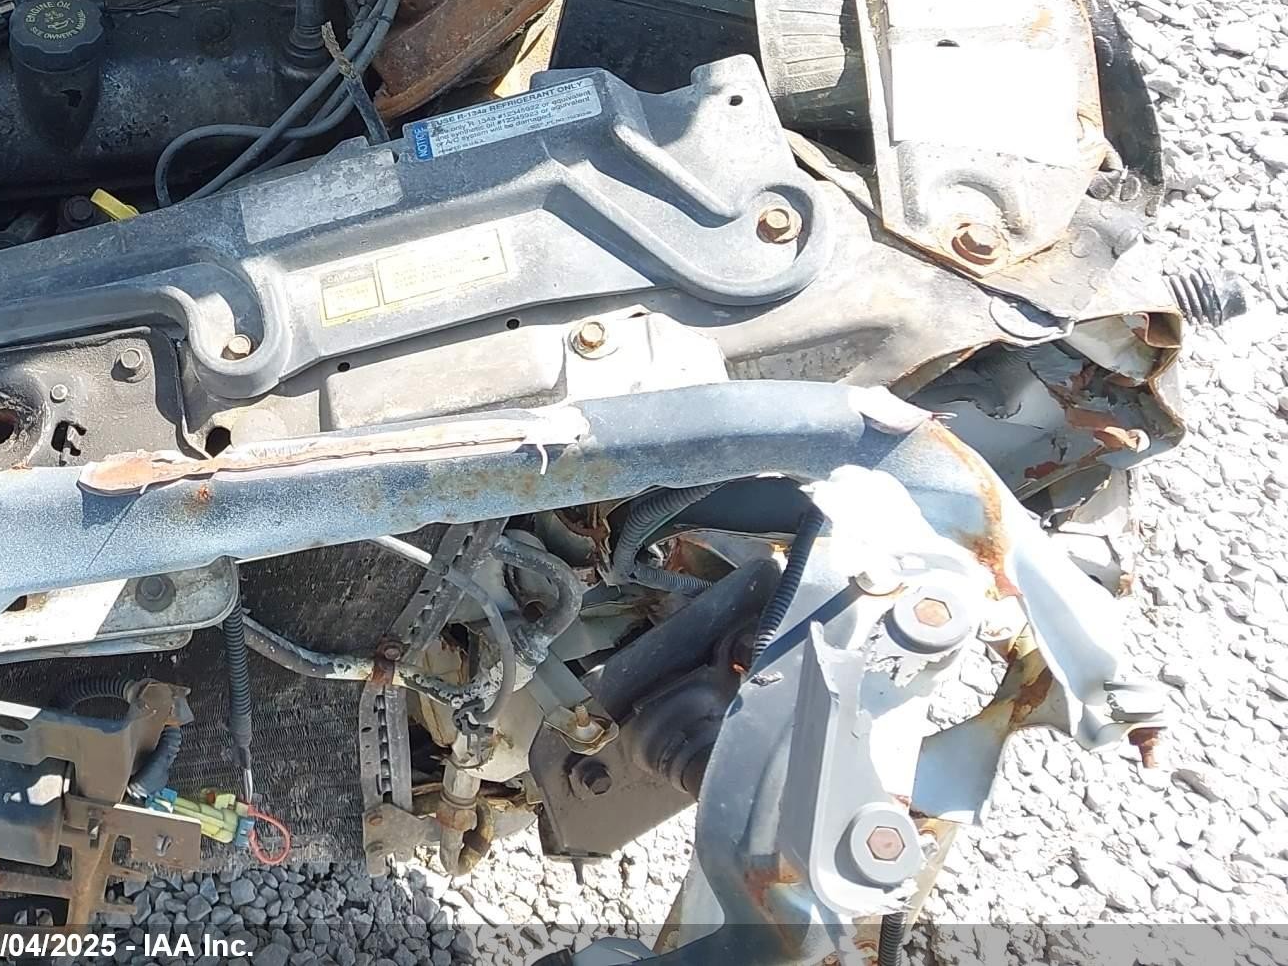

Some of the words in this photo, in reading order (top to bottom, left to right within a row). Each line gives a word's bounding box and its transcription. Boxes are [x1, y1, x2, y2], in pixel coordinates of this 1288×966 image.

[25, 1, 55, 23] ENGINE
[56, 0, 71, 10] OIL
[488, 87, 556, 112] REFRIGERANT
[555, 80, 583, 93] ONLY
[549, 95, 591, 113] equivalent
[550, 89, 592, 107] equivalent
[411, 126, 430, 158] NOTICE
